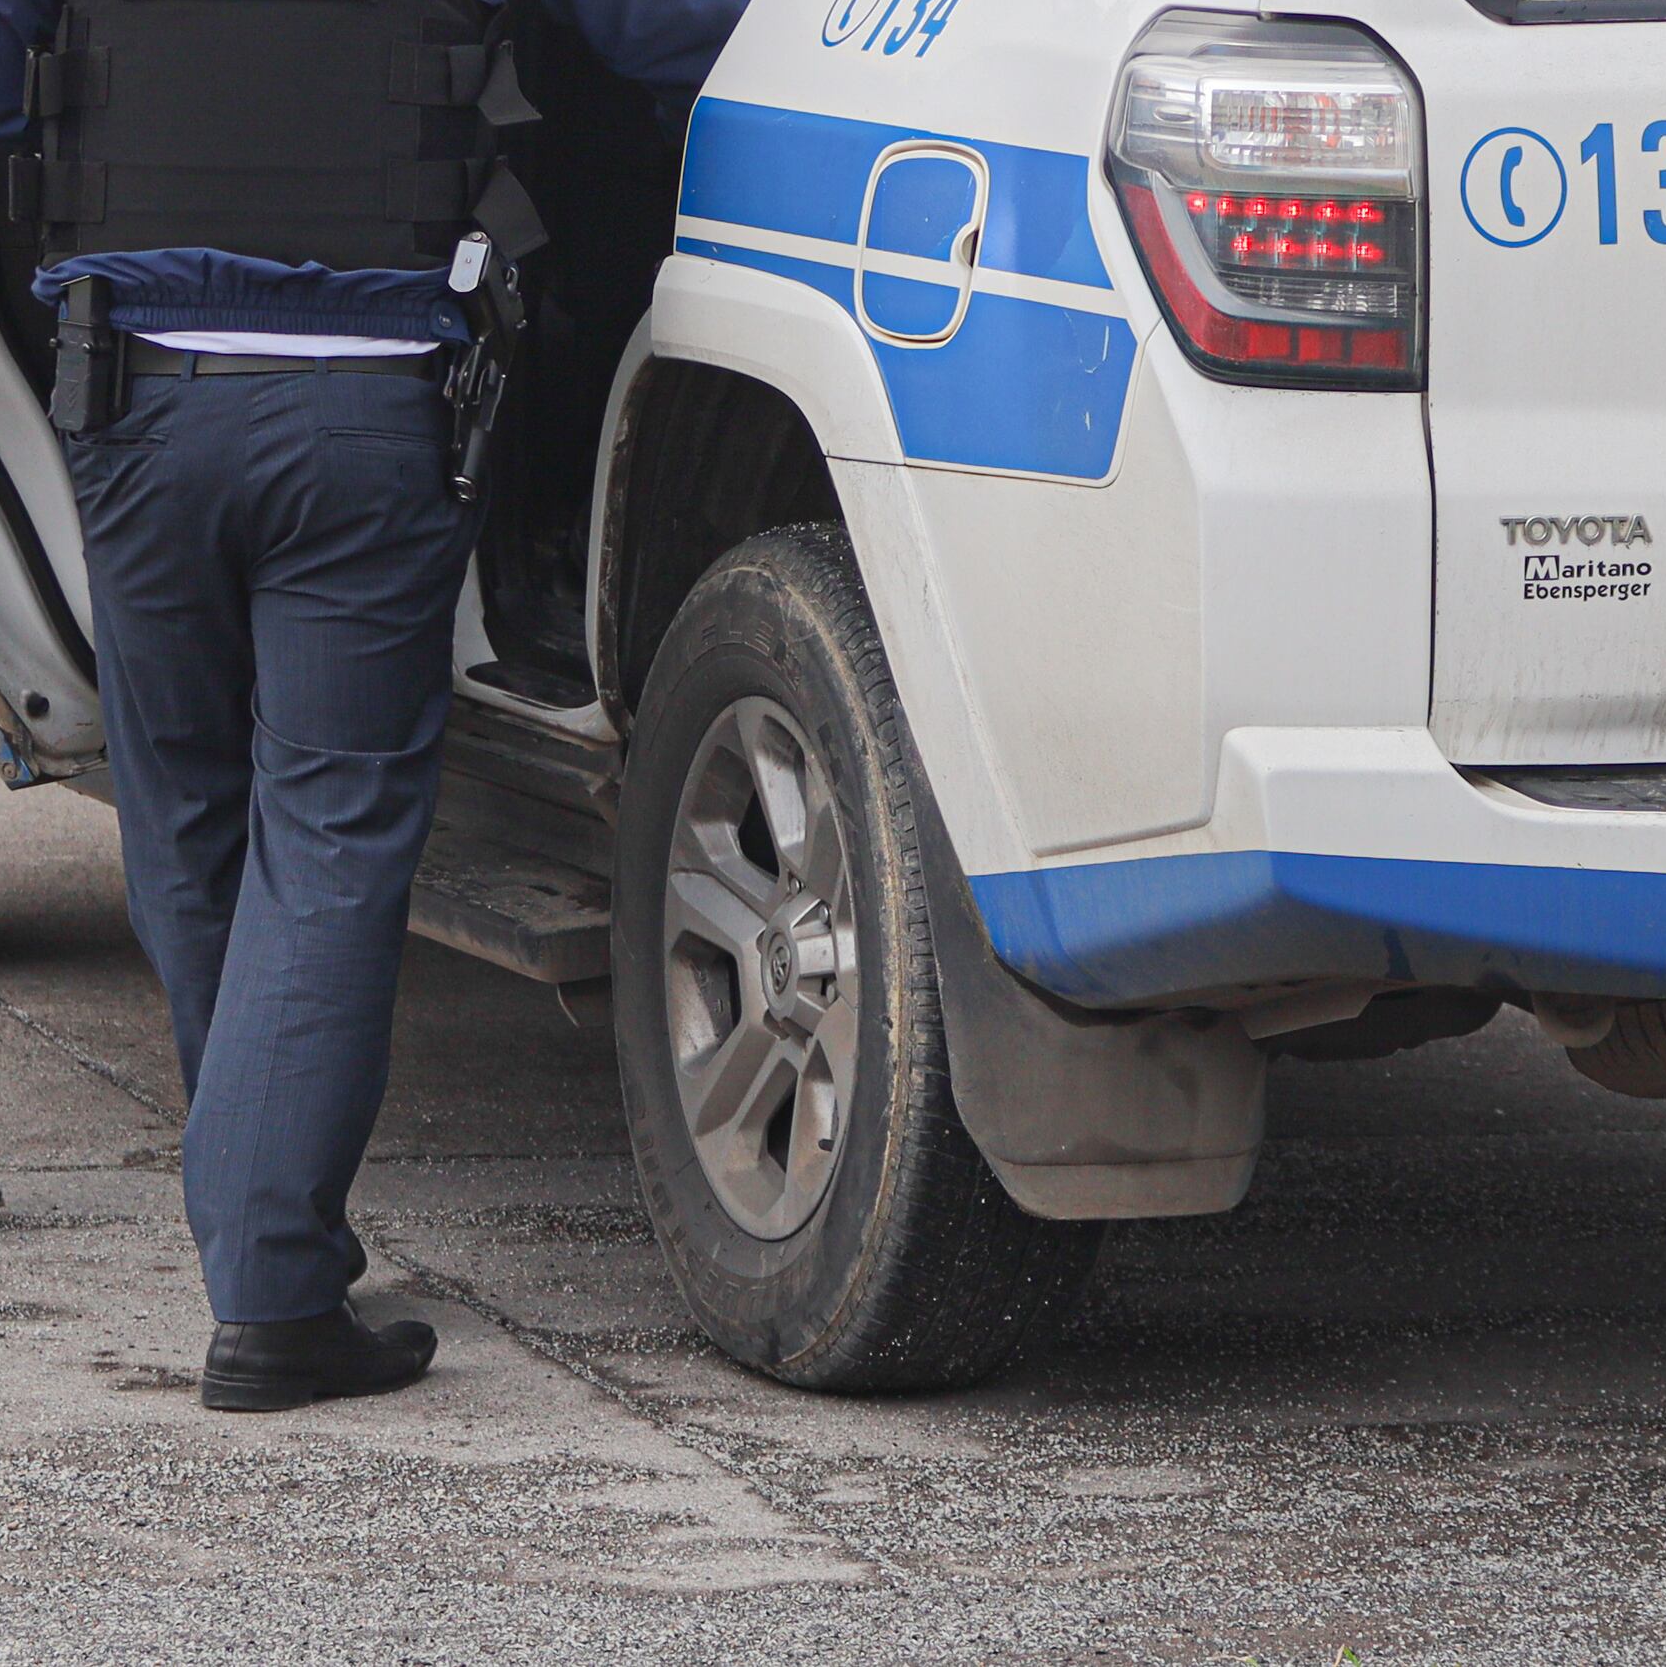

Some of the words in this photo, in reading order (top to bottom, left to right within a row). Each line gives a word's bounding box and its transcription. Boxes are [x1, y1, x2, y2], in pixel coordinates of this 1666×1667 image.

[1499, 512, 1653, 546] TOYOTA
[1524, 554, 1653, 582] Maritano
[1523, 582, 1652, 602] Ebensperger
